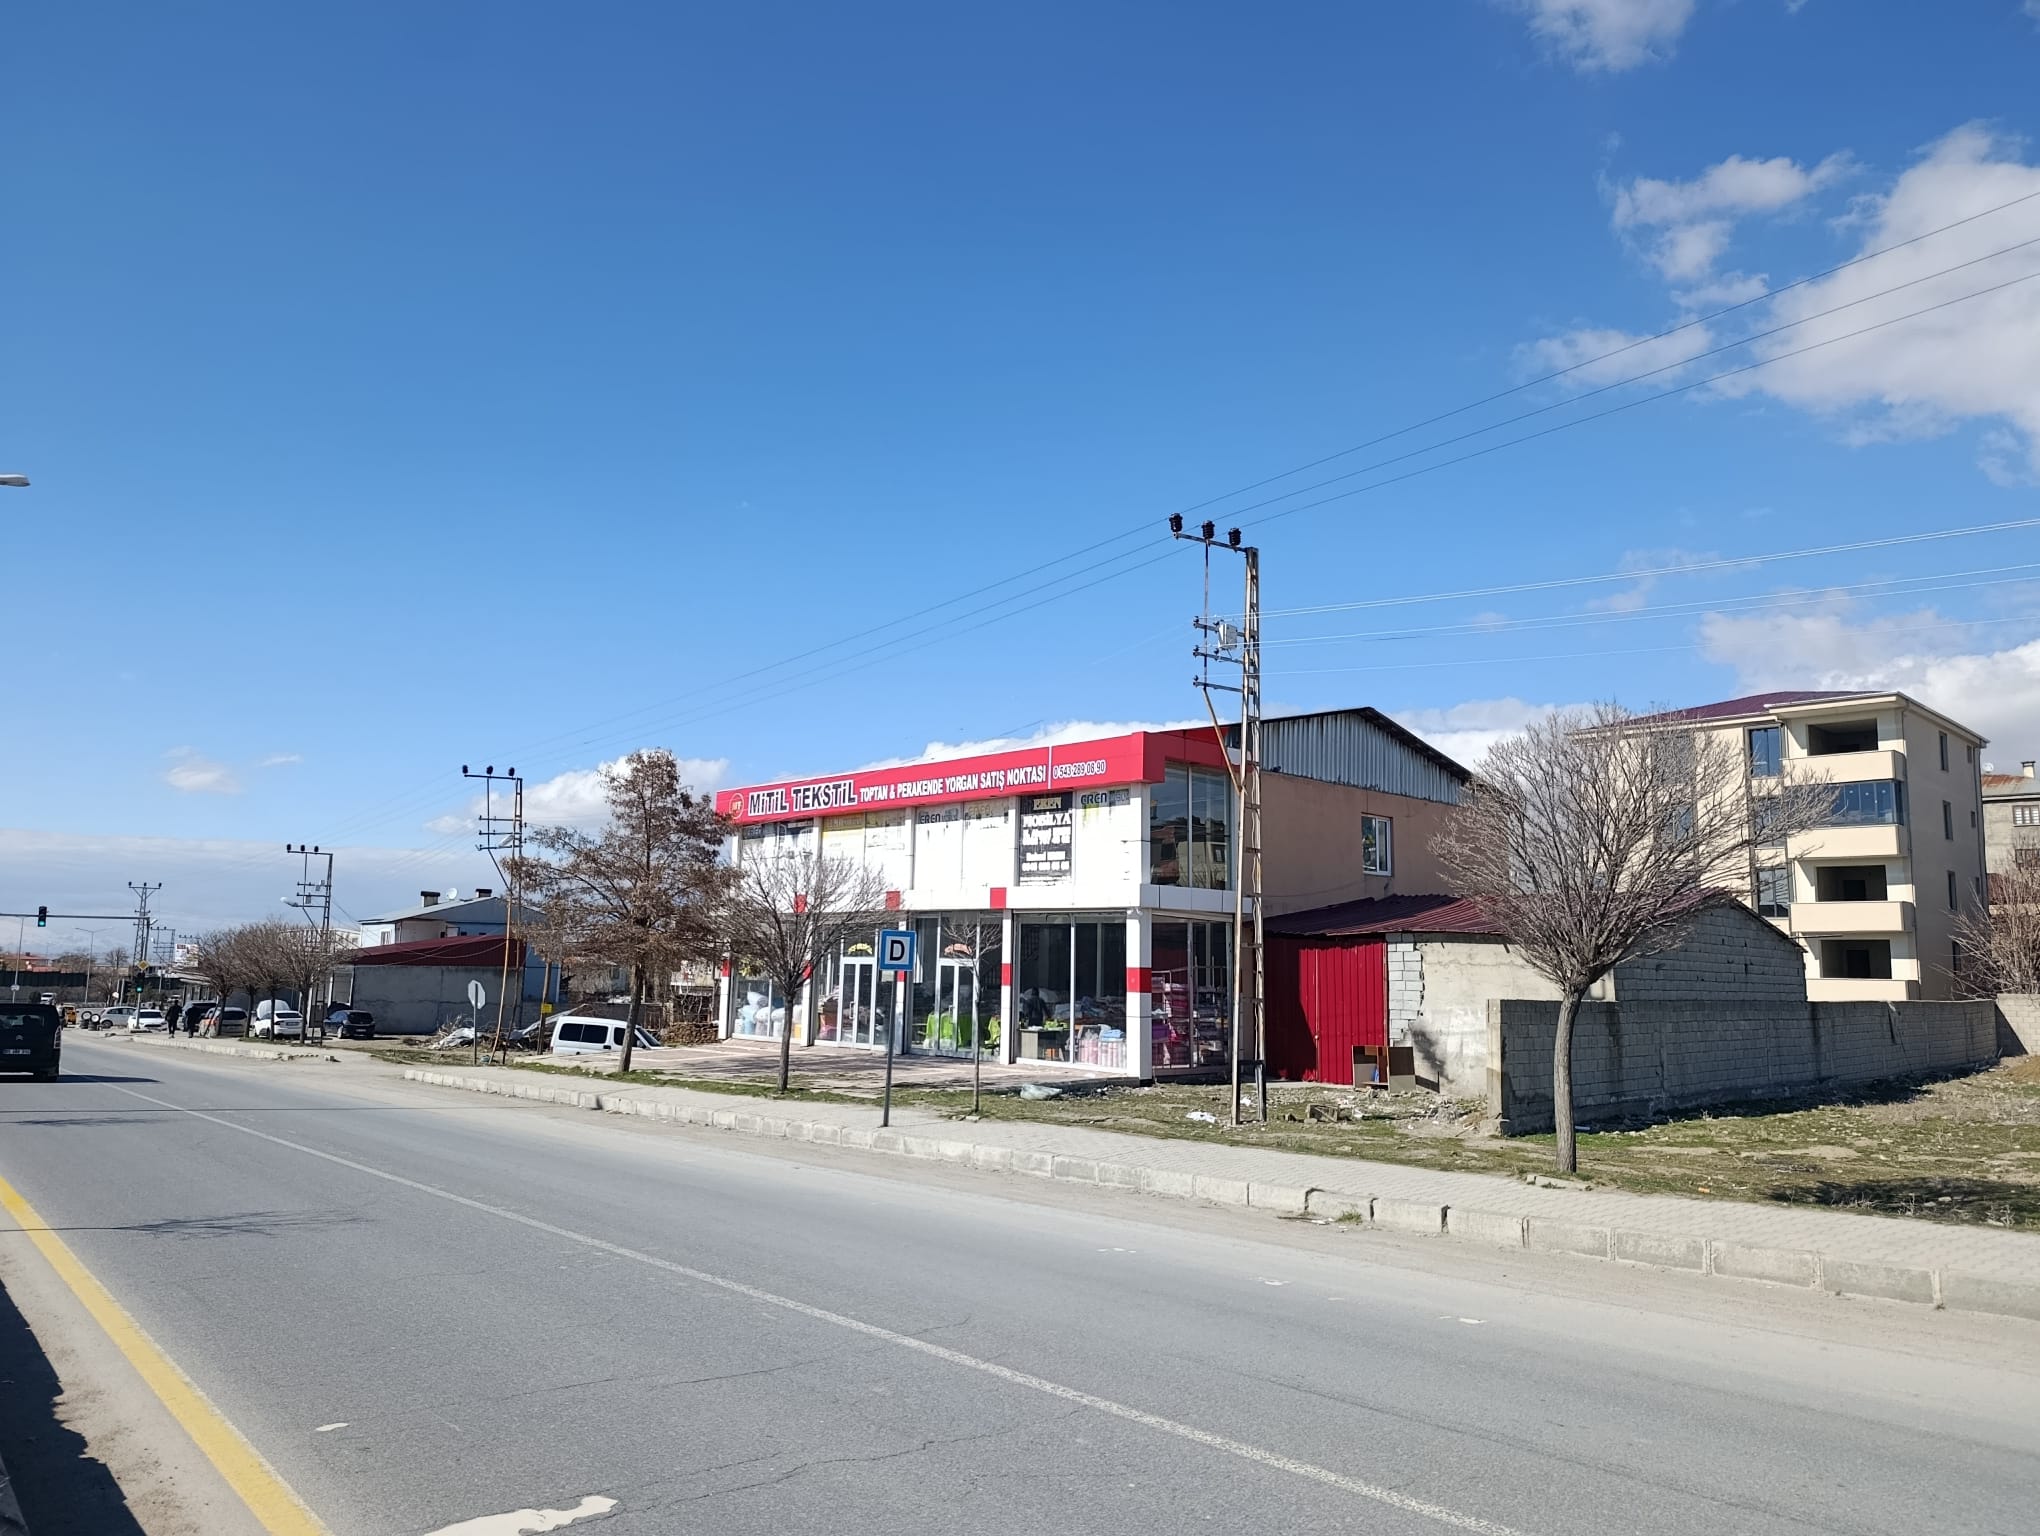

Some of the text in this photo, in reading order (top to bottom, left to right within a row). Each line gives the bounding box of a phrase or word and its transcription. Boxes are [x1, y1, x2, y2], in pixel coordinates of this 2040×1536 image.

[860, 765, 1046, 802] TOPTAN & PERAKENDE YORGAN SATIŞ NOKTASI
[889, 939, 906, 962] D
